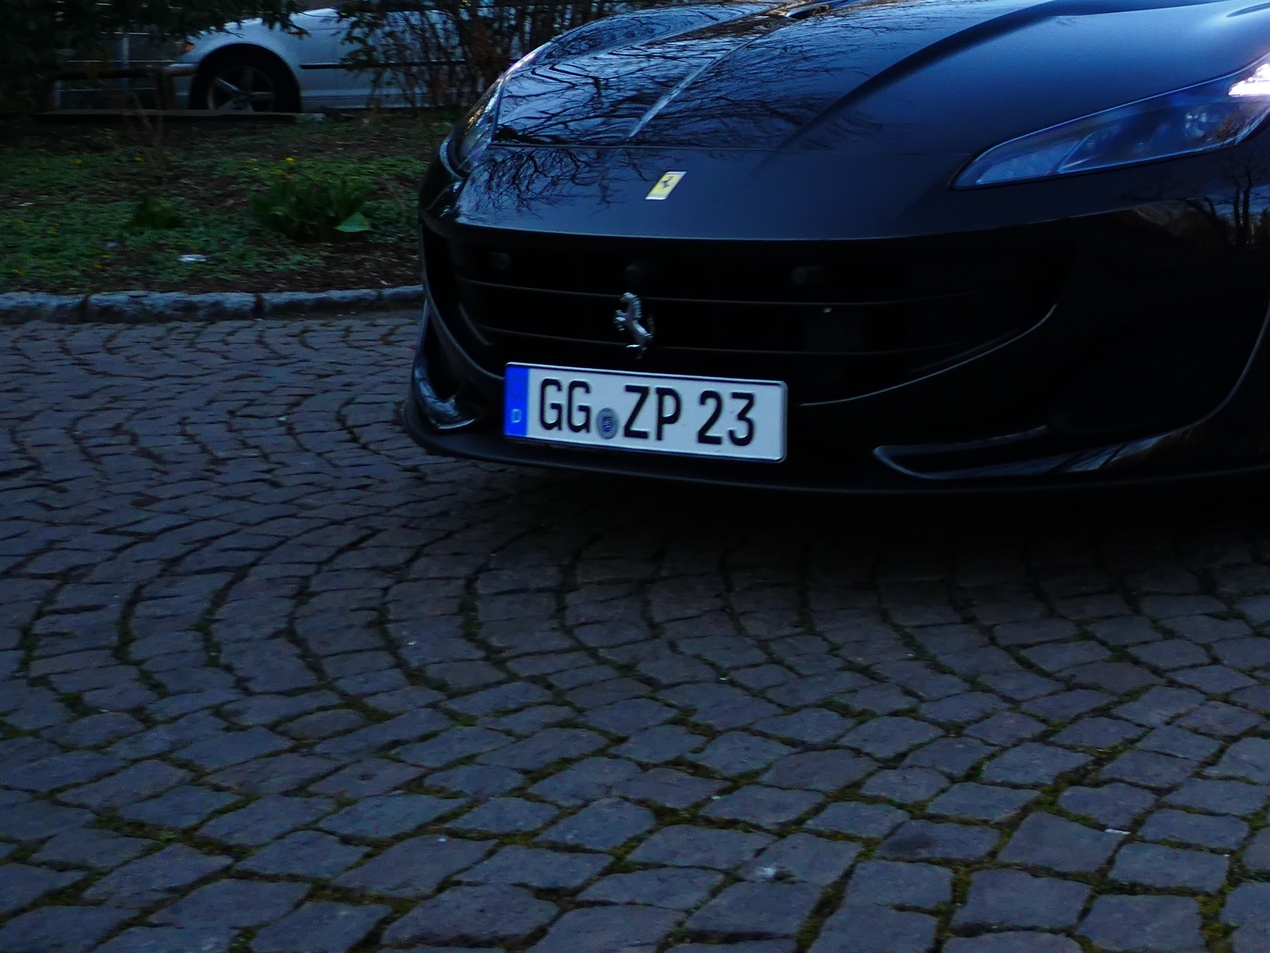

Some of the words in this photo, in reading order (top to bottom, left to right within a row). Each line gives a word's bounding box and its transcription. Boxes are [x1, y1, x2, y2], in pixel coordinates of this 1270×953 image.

[511, 408, 522, 423] D
[539, 377, 591, 434] GG
[622, 383, 682, 441] ZP
[697, 389, 756, 447] 23
